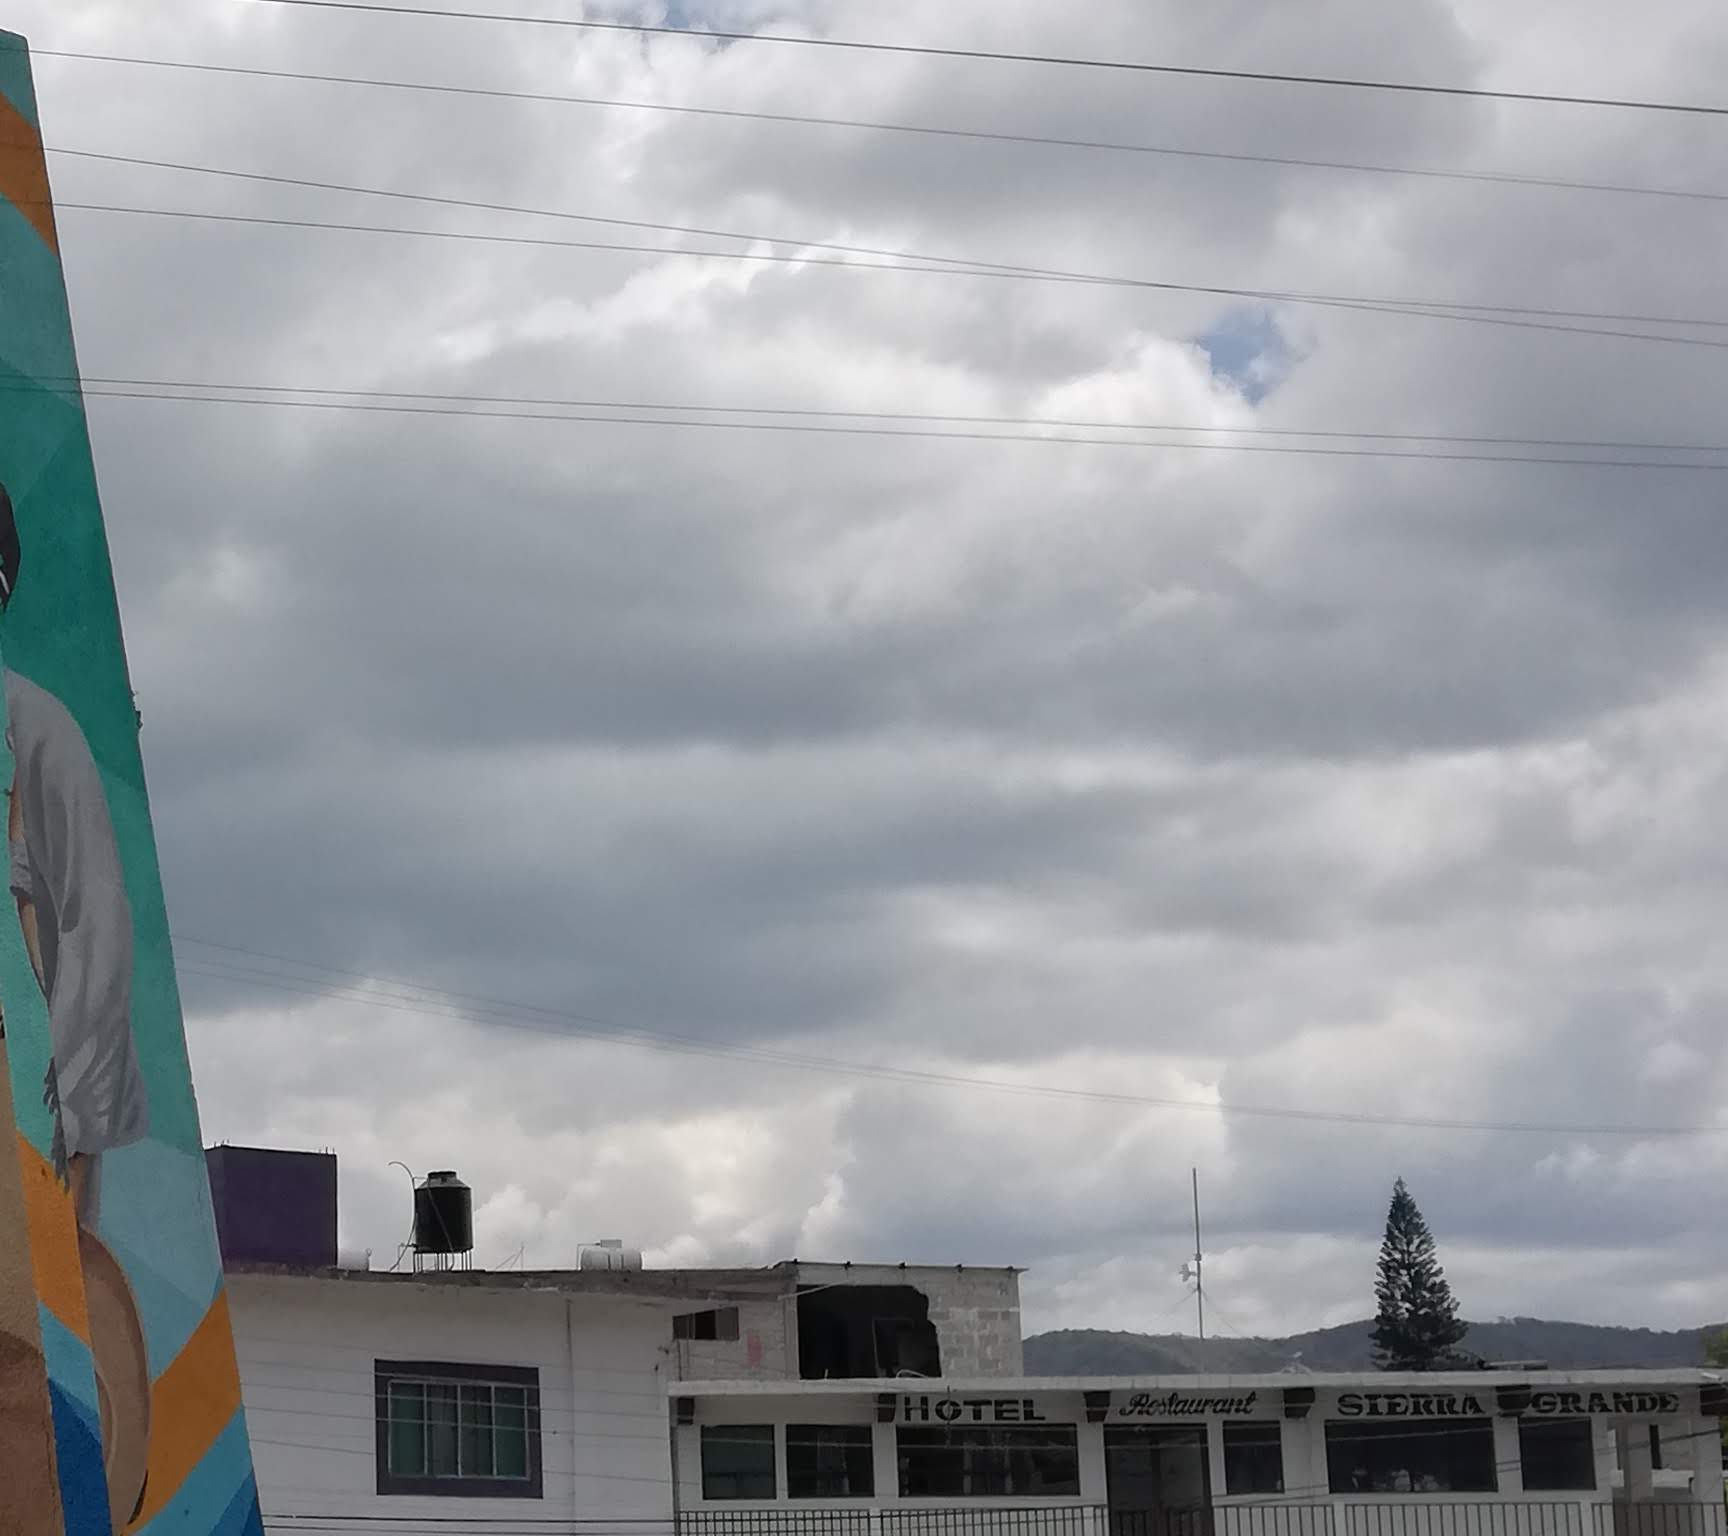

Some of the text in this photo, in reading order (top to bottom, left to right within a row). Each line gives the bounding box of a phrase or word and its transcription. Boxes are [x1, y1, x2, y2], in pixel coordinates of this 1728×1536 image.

[904, 1391, 1680, 1422] HOTEL Restaurant SIERRA GRANDE
